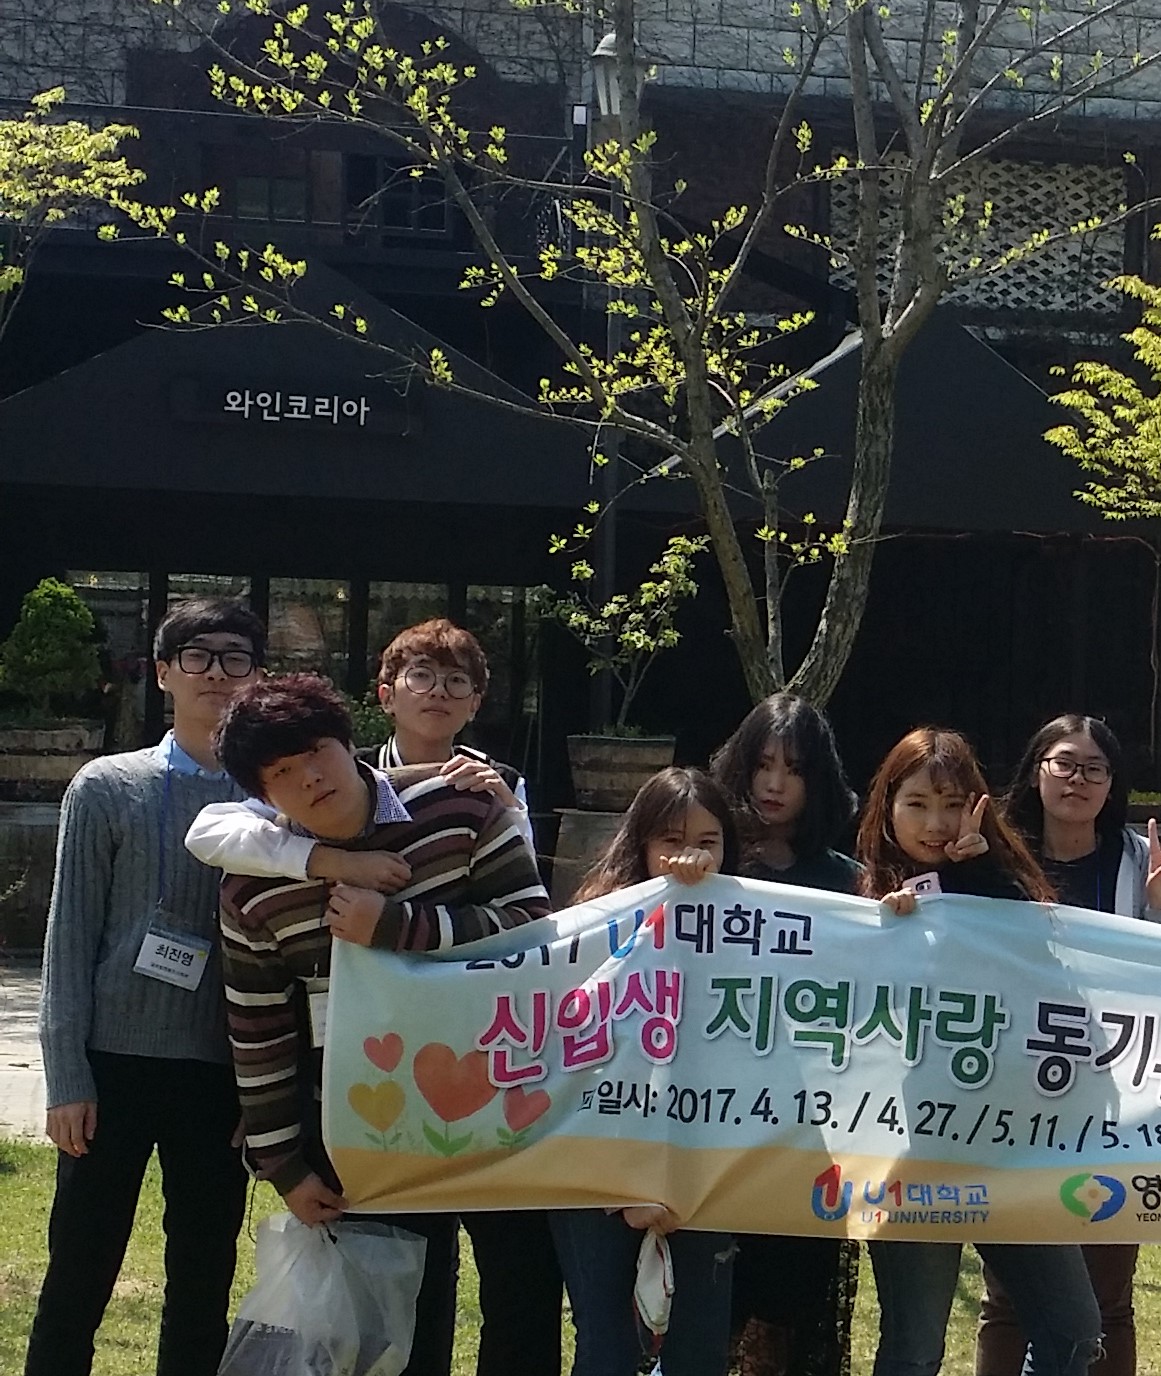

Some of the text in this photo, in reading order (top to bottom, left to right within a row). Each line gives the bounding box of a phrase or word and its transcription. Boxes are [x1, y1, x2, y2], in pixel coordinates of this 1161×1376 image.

[223, 389, 371, 426] 와인코리아
[155, 944, 194, 966] 최진영
[479, 970, 683, 1083] 신입생
[705, 976, 1006, 1085] 지역사랑
[597, 1080, 658, 1118] 일시:
[667, 1084, 742, 1125] 2017.
[750, 1087, 779, 1125] 4.
[793, 1090, 839, 1129] 13.
[863, 1180, 990, 1207] U1대학교
[887, 1211, 990, 1224] UNIVERSITY
